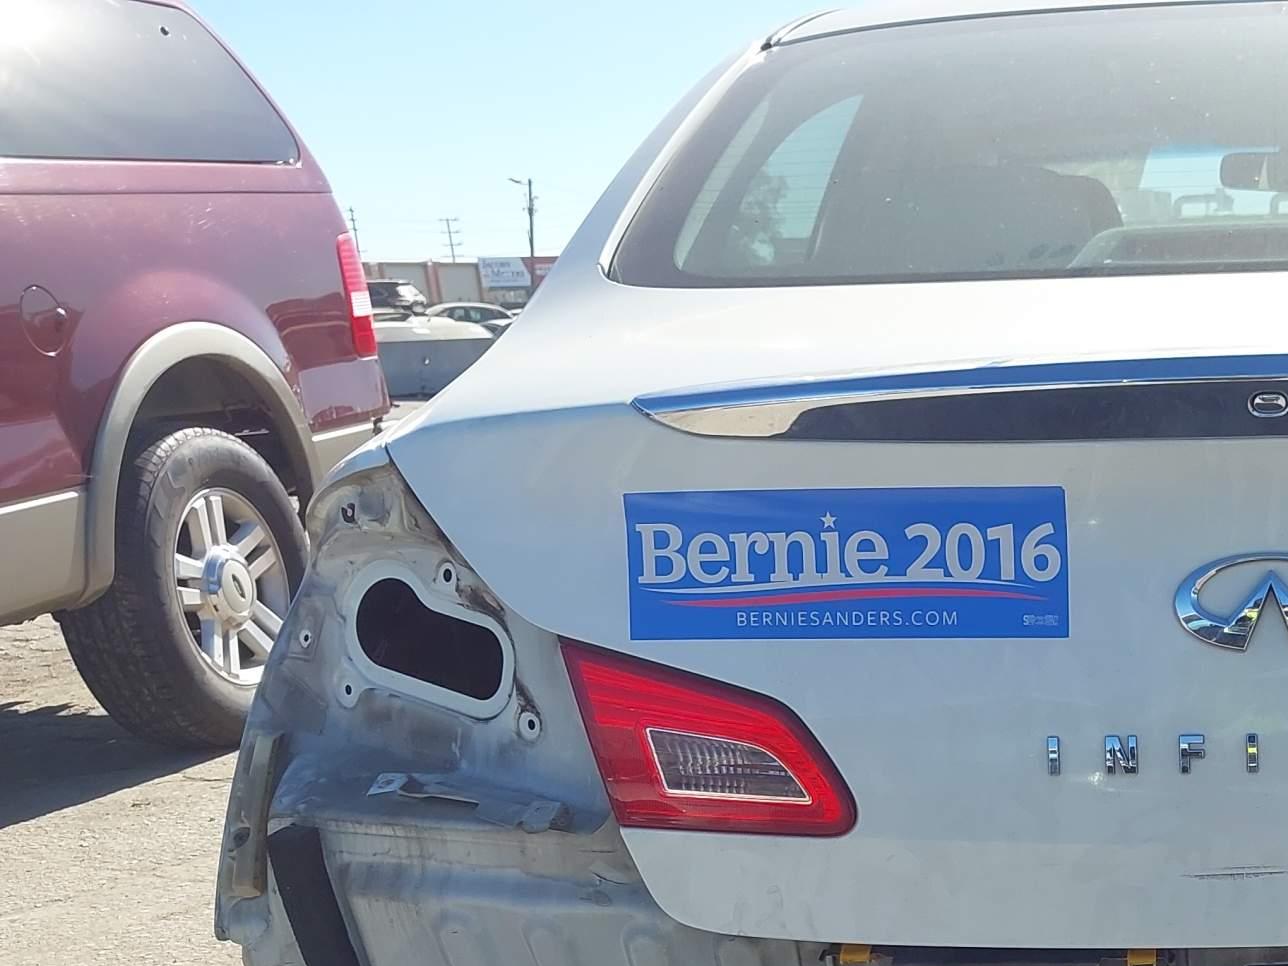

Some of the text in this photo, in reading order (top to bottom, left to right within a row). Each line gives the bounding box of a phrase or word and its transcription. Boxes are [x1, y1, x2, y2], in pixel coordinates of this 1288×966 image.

[635, 513, 1062, 583] Bernie 2016
[736, 611, 958, 627] BERNIESANDERS.COM
